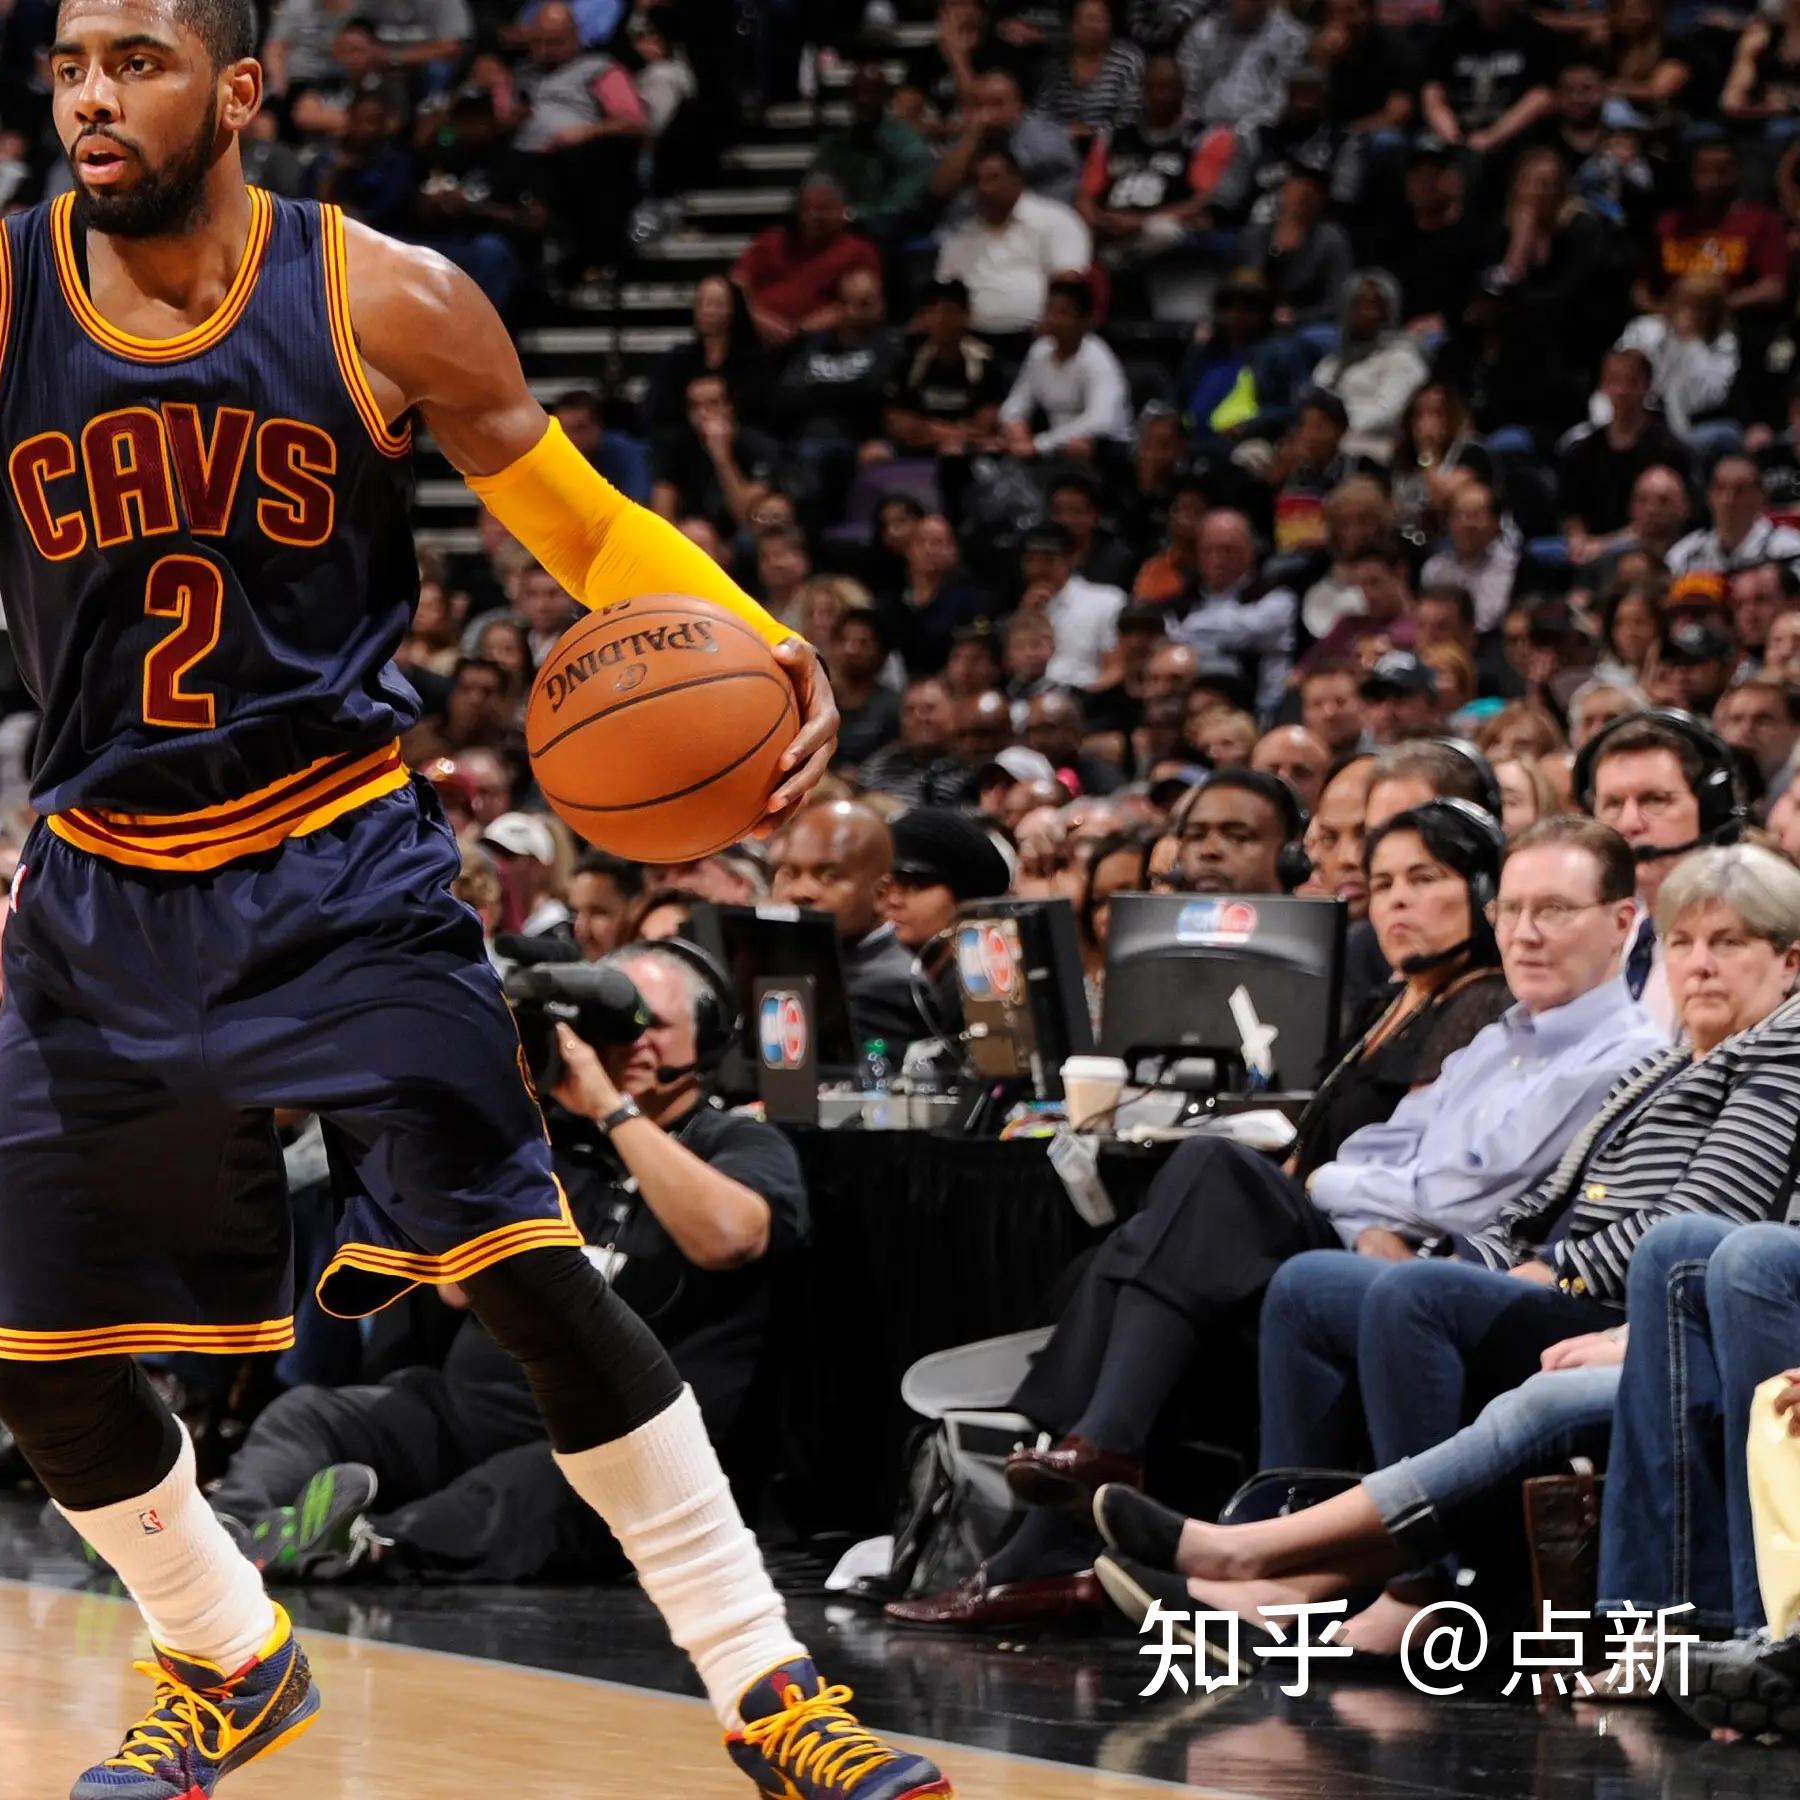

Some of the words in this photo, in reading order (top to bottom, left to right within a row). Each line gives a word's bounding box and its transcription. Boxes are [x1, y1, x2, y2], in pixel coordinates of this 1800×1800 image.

[9, 402, 337, 561] CAVS
[143, 554, 223, 728] 2
[541, 620, 718, 713] SPALDING
